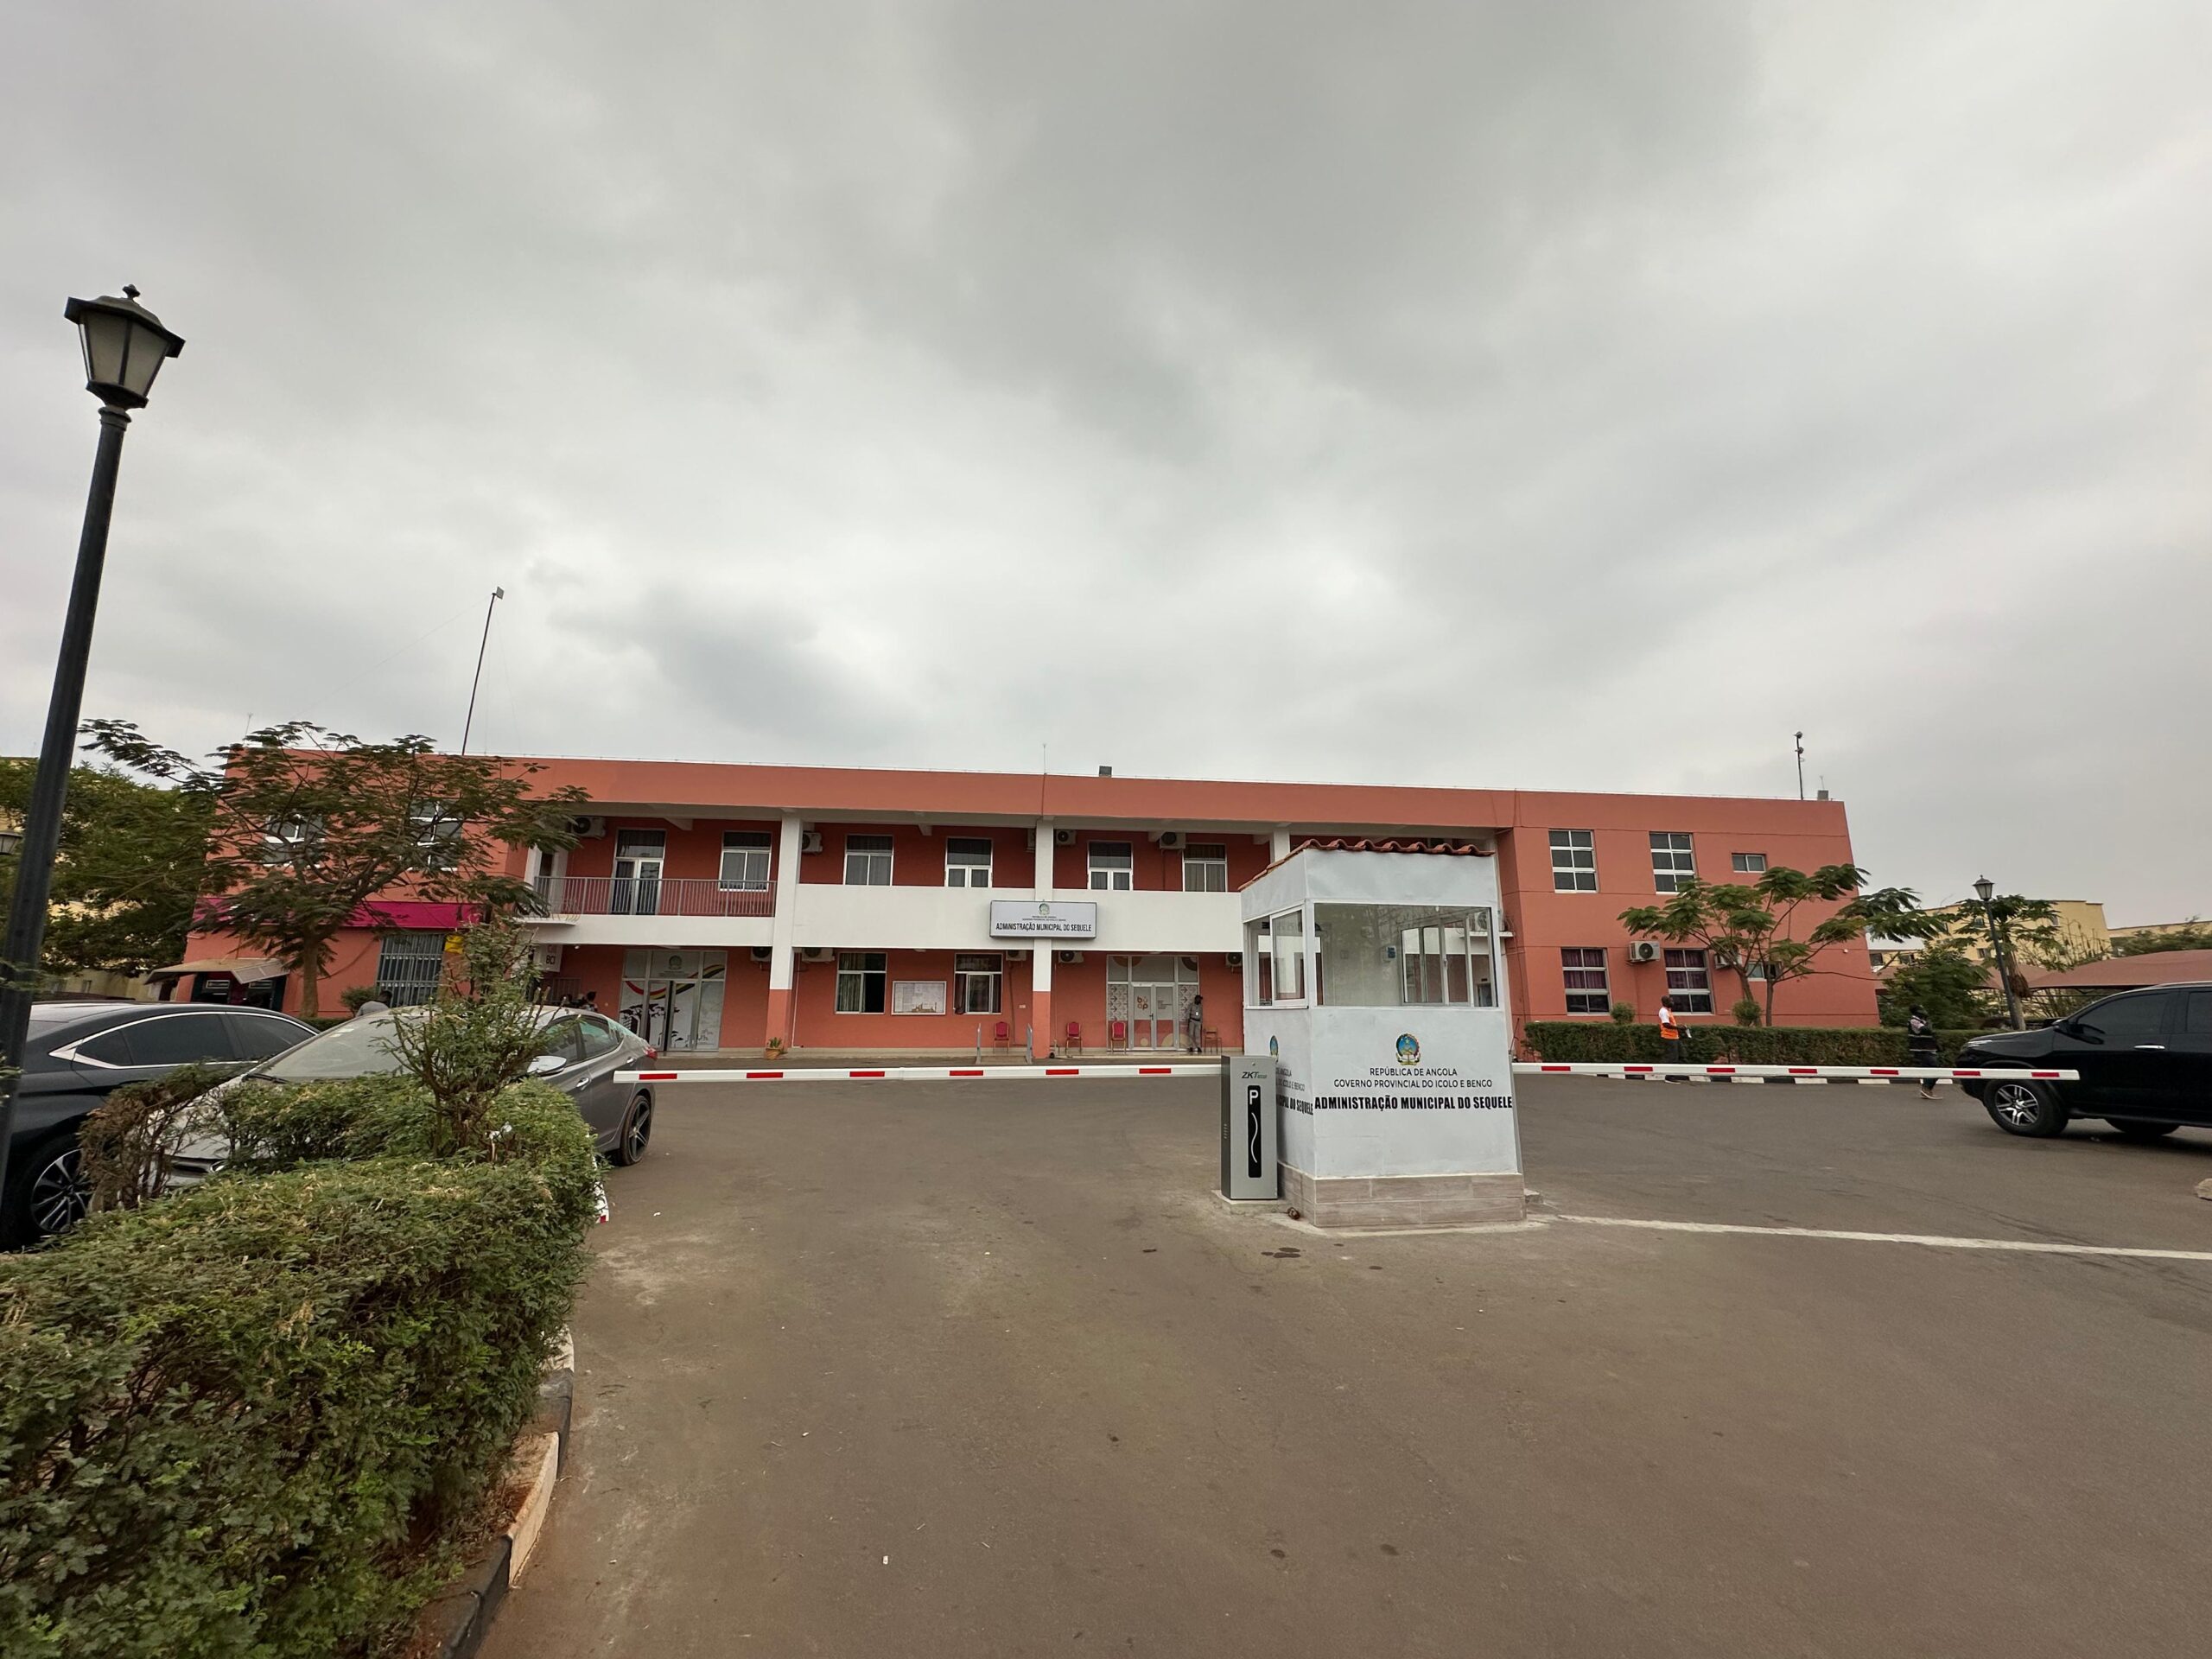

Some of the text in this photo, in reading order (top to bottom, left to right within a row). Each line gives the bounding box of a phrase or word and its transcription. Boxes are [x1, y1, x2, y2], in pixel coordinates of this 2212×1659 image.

[995, 922, 1035, 931] ADMINISTRAÇÃO
[1036, 923, 1062, 931] MUNICIPAL
[1370, 1066, 1412, 1076] REPÚBLICA
[1334, 1079, 1372, 1088] GOVERNO
[1374, 1079, 1420, 1088] PROVINCIAL
[1249, 1090, 1259, 1104] P
[1314, 1095, 1512, 1111] ADMINISTRAÇÃO MUNICIPAL DO SEQUELE
[1289, 1098, 1296, 1110] DO
[1296, 1099, 1313, 1116] SEQUELE
